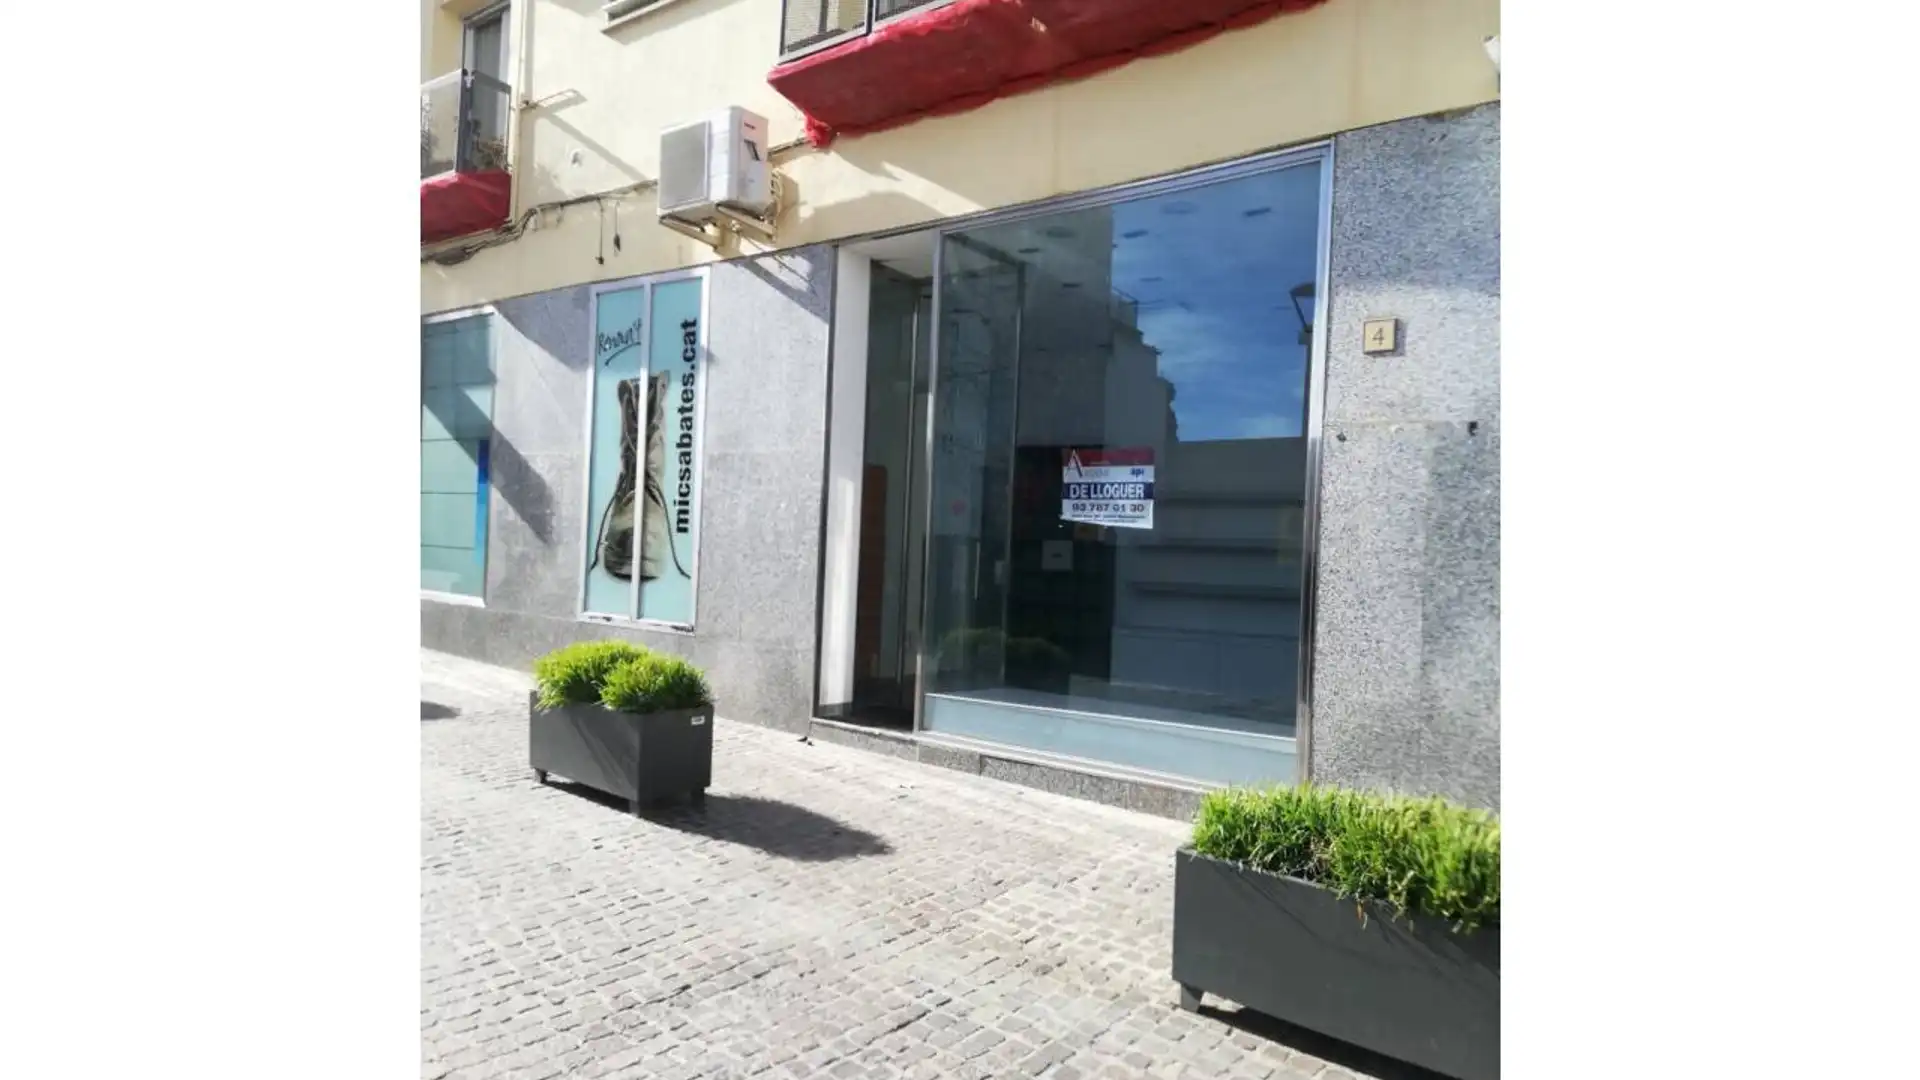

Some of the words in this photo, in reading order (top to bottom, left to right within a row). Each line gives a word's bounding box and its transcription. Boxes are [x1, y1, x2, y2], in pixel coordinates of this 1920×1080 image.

[1372, 327, 1385, 346] 4
[674, 318, 697, 534] micsabates.cat
[1069, 484, 1089, 498] DE
[1090, 484, 1144, 499] LLOGUER
